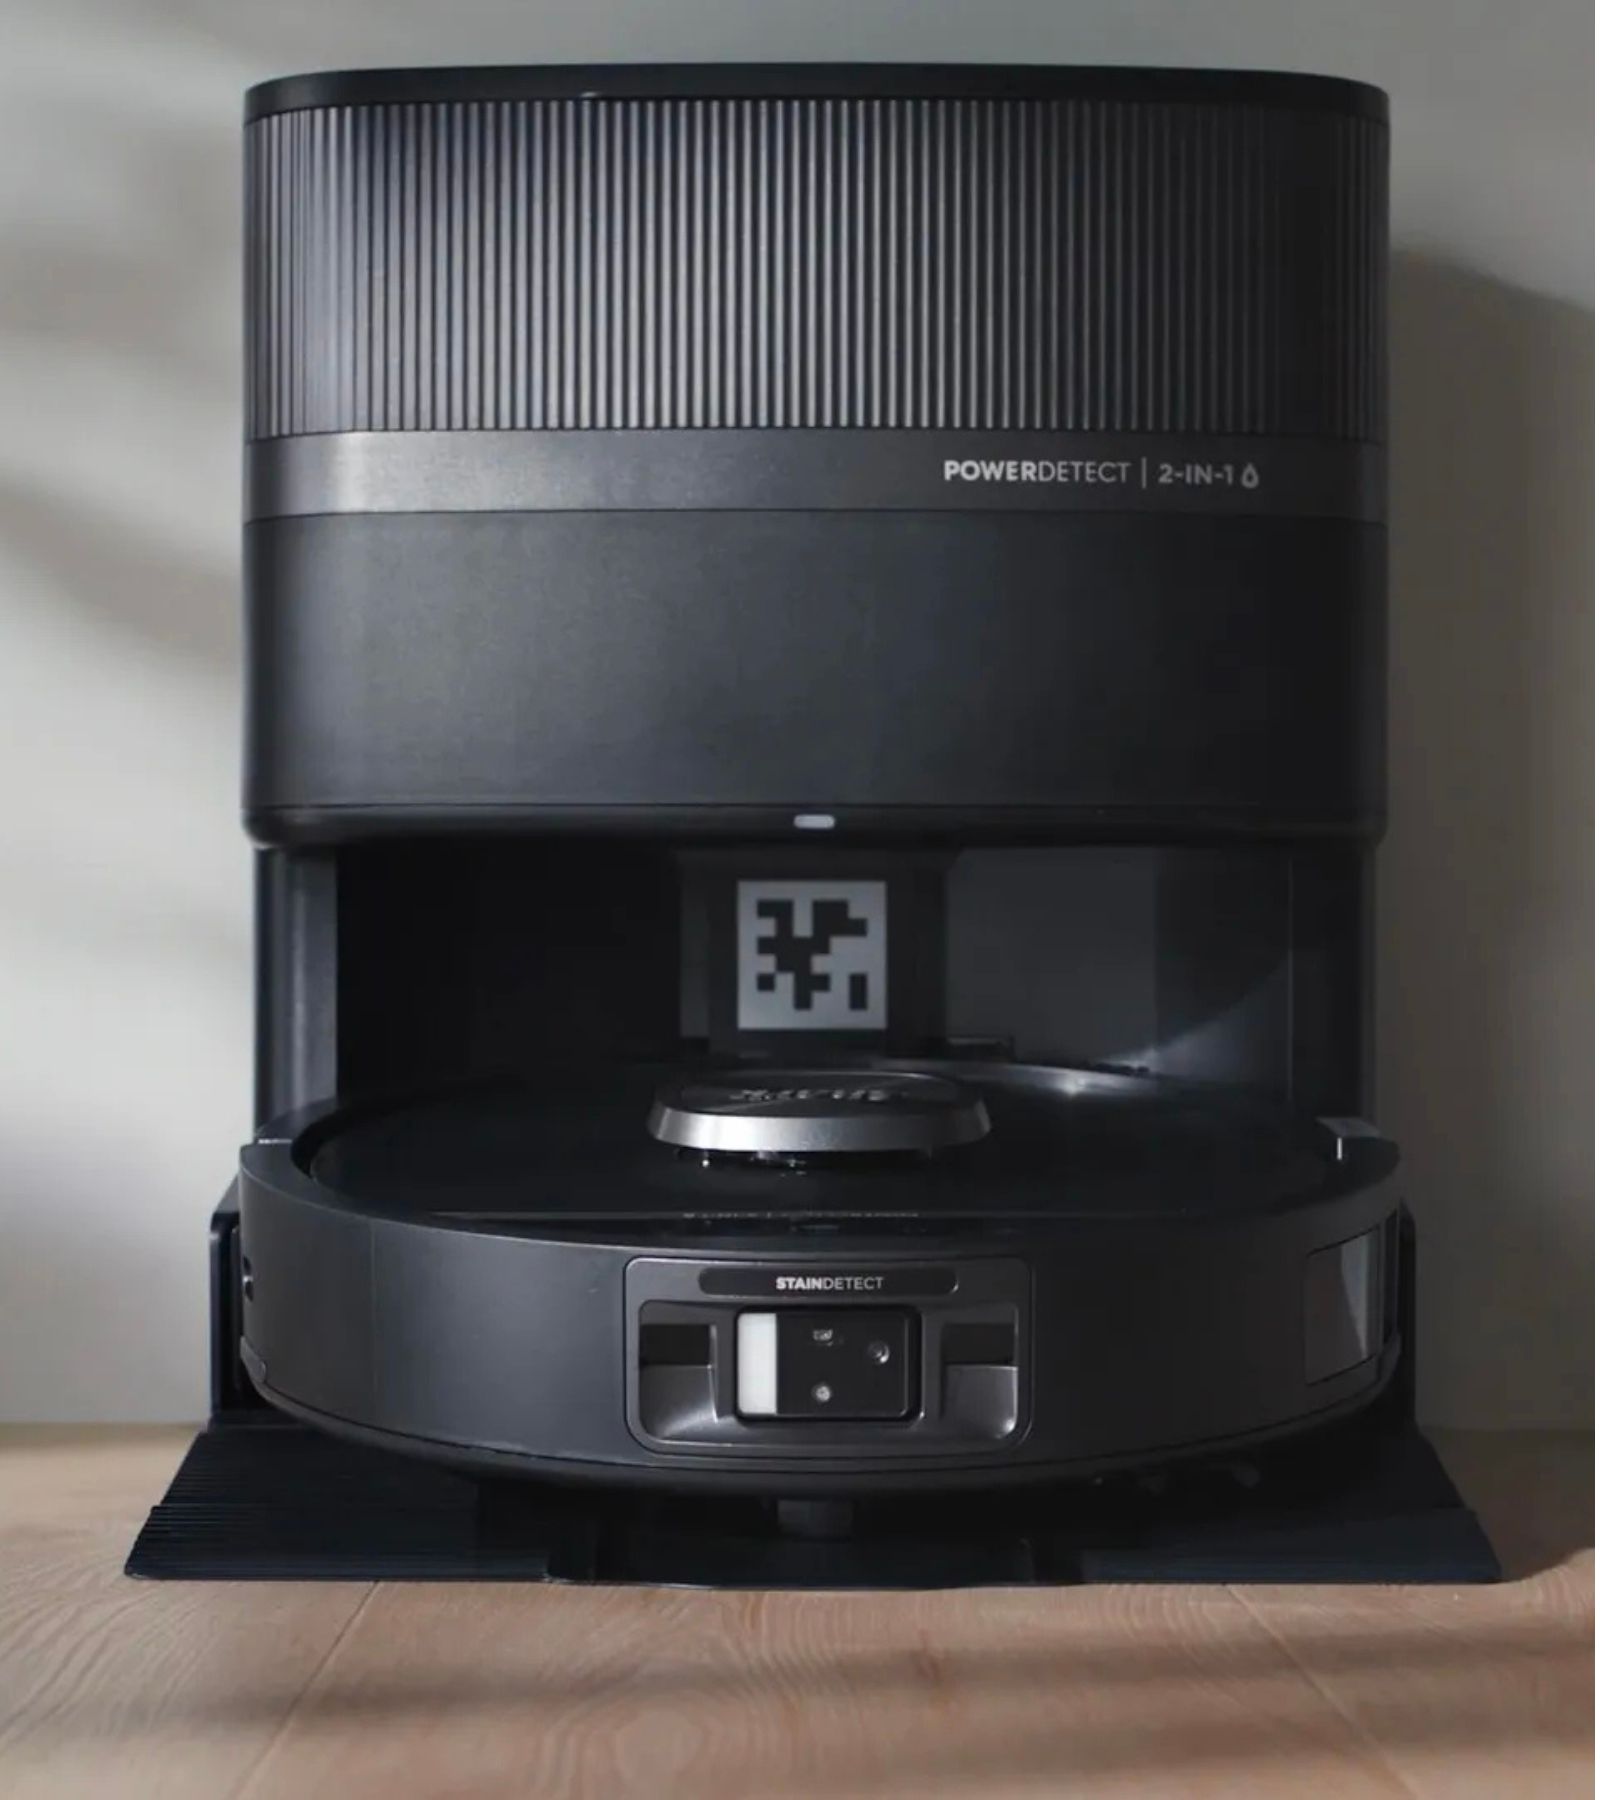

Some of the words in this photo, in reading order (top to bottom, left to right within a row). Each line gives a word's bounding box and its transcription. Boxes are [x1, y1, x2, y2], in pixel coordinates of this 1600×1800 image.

[943, 460, 1132, 483] POWERDETECT
[1157, 463, 1234, 485] 2-IN-1
[775, 1275, 885, 1292] STAINDETECT
